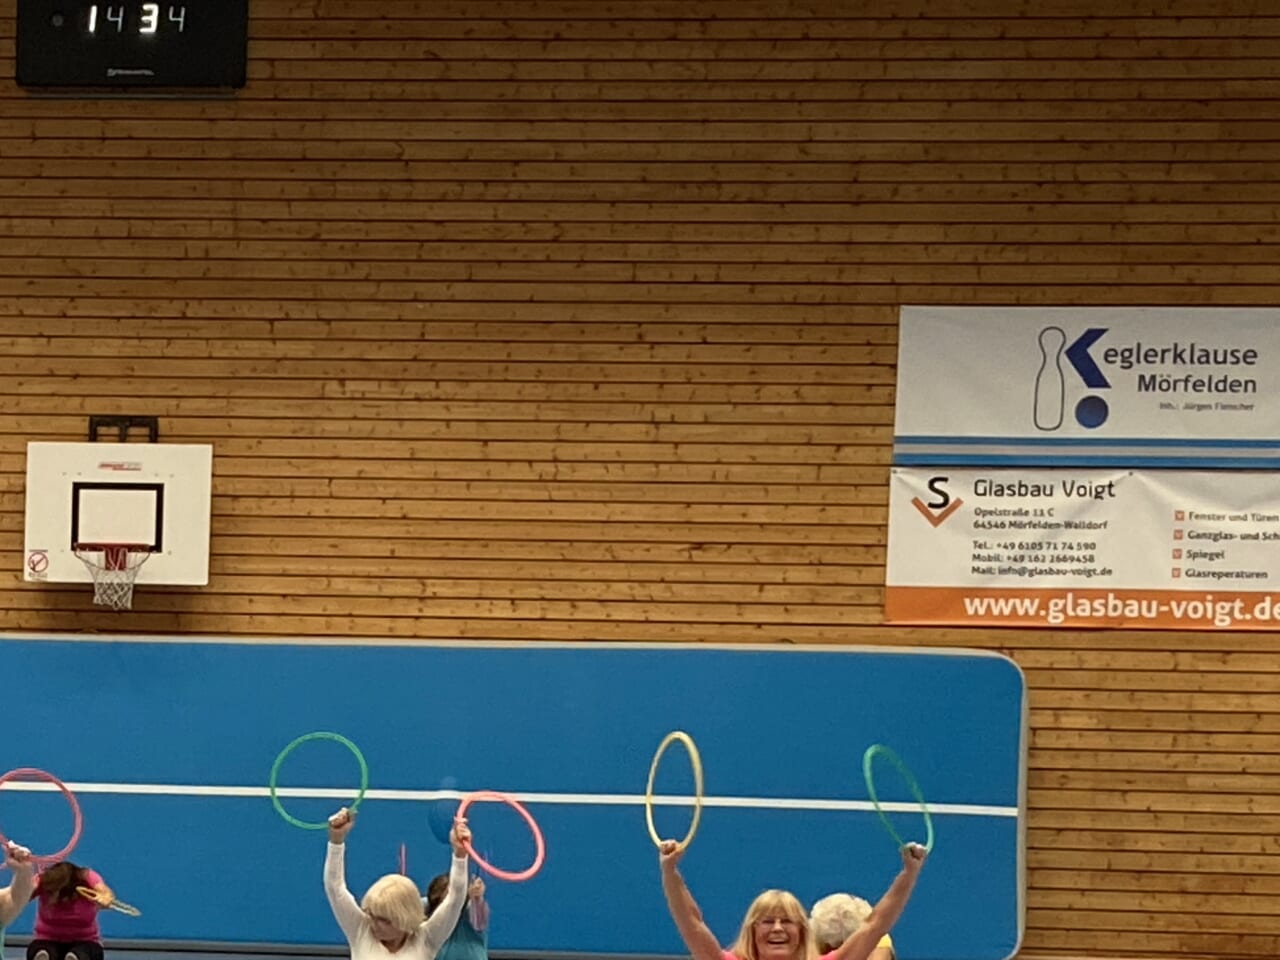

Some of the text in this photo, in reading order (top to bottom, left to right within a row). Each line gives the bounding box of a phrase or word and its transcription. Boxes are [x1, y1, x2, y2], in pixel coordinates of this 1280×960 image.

[1137, 373, 1257, 394] Mörfelden
[973, 479, 1116, 500] Glasbau Voigt
[974, 507, 1030, 518] Opelstraße
[1228, 513, 1248, 521] und
[973, 520, 1006, 529] 64546
[1239, 532, 1260, 540] und
[996, 542, 1016, 550] +49
[1045, 542, 1058, 550] 71
[1061, 542, 1074, 550] 74
[1186, 549, 1225, 561] Spiegel
[963, 592, 1280, 627] www.glasbau-voigt.de
